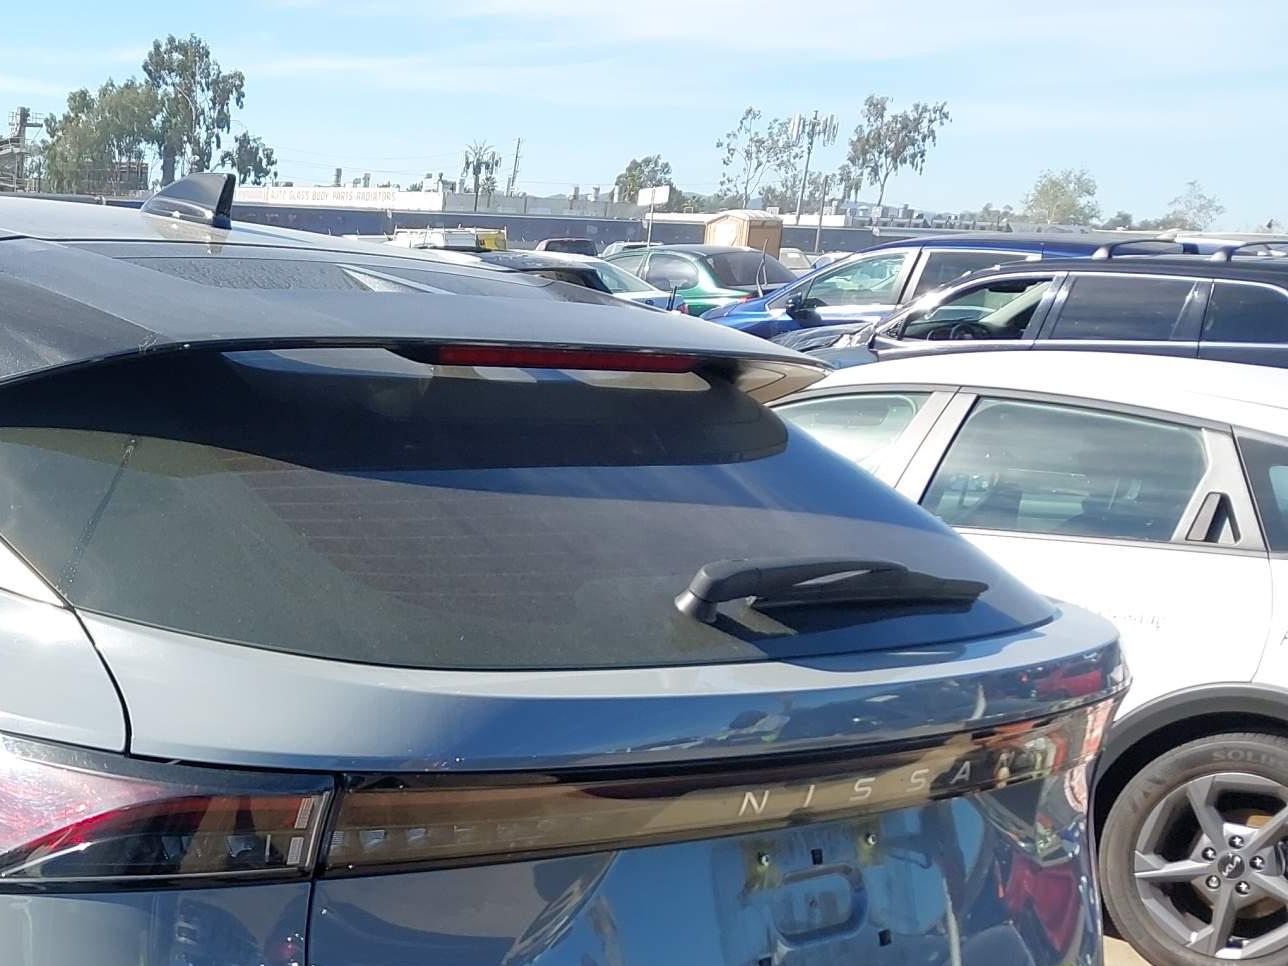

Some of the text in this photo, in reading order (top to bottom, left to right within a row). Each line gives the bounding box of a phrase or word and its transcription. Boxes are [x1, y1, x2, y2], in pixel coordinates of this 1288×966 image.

[289, 190, 310, 200] GLASS
[312, 191, 328, 200] BODY
[332, 191, 353, 201] PARTS
[356, 191, 396, 202] RADIATORS
